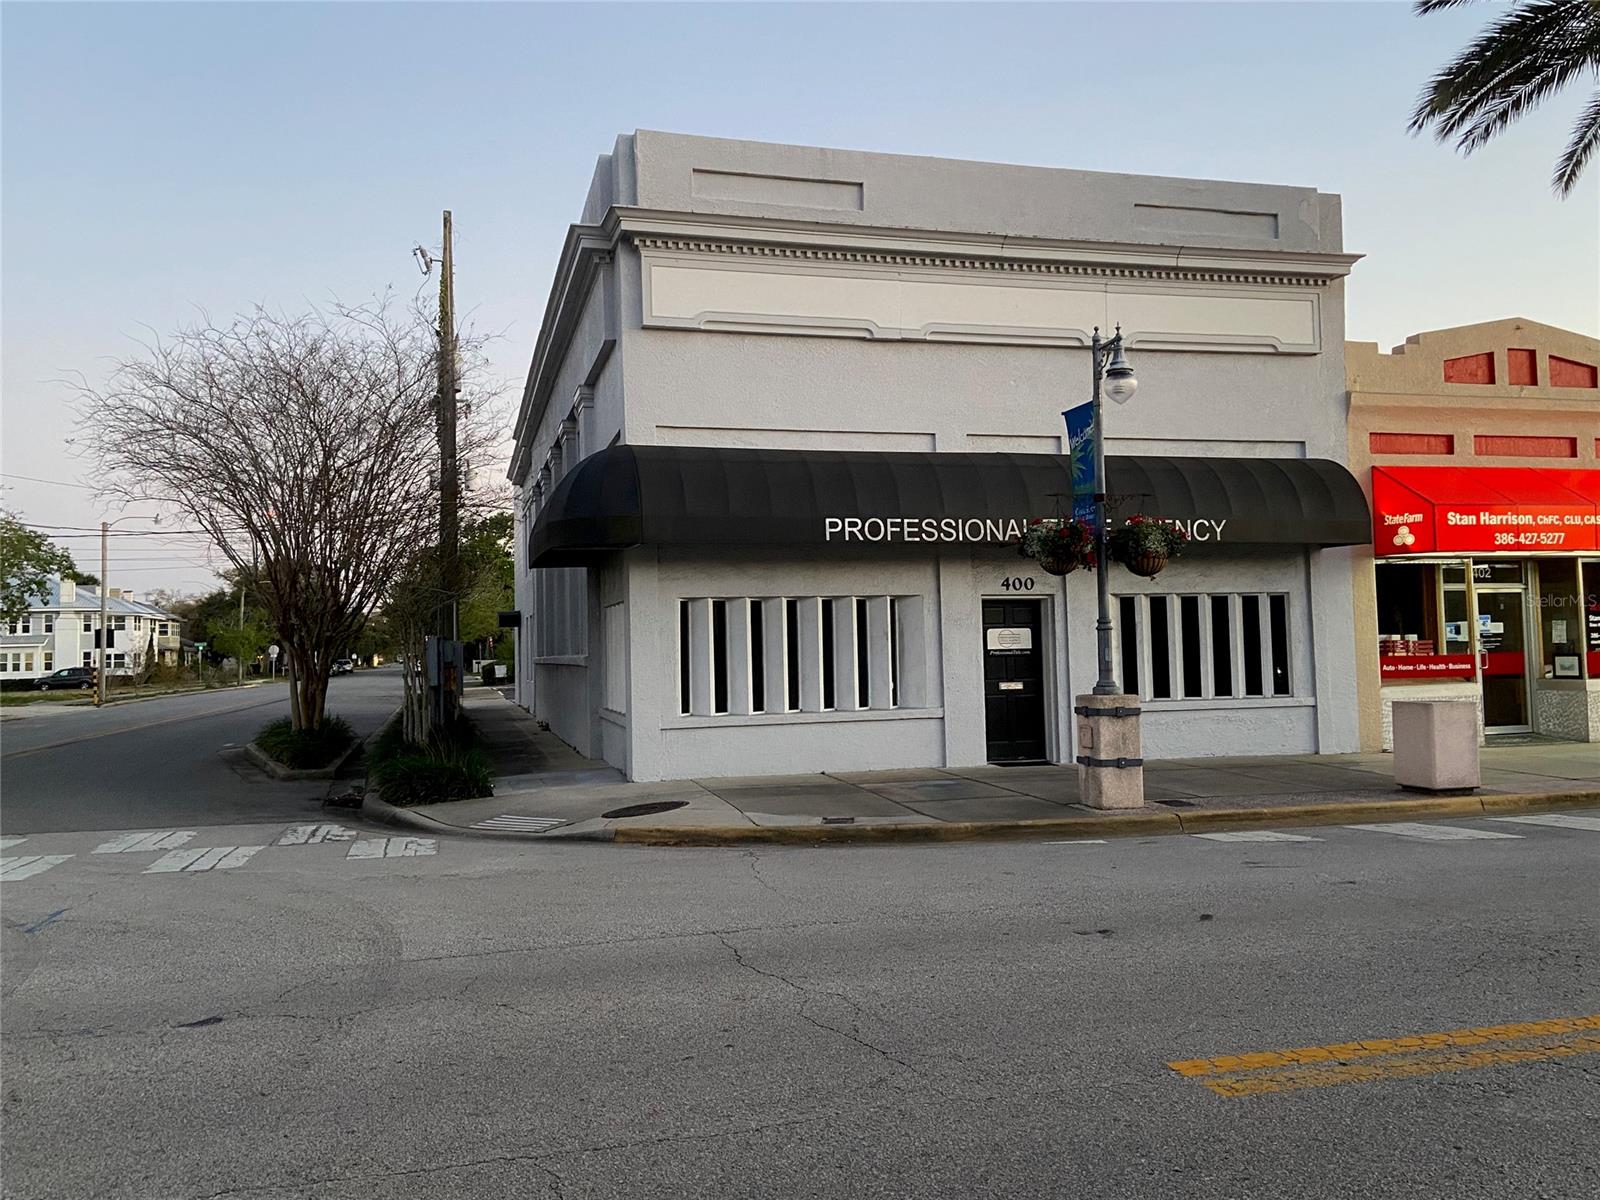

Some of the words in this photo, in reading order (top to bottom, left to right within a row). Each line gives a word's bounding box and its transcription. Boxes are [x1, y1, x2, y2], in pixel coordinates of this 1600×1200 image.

[1447, 511, 1477, 525] Stan
[1479, 512, 1536, 526] Harrison,
[1537, 515, 1562, 526] ChFC,
[1564, 515, 1583, 526] CLU,
[1494, 532, 1565, 544] 386-427-5277
[1473, 567, 1492, 579] 402
[1001, 577, 1035, 591] 400
[1416, 663, 1427, 671] Life
[1429, 663, 1447, 671] Health
[1448, 662, 1471, 670] Business
